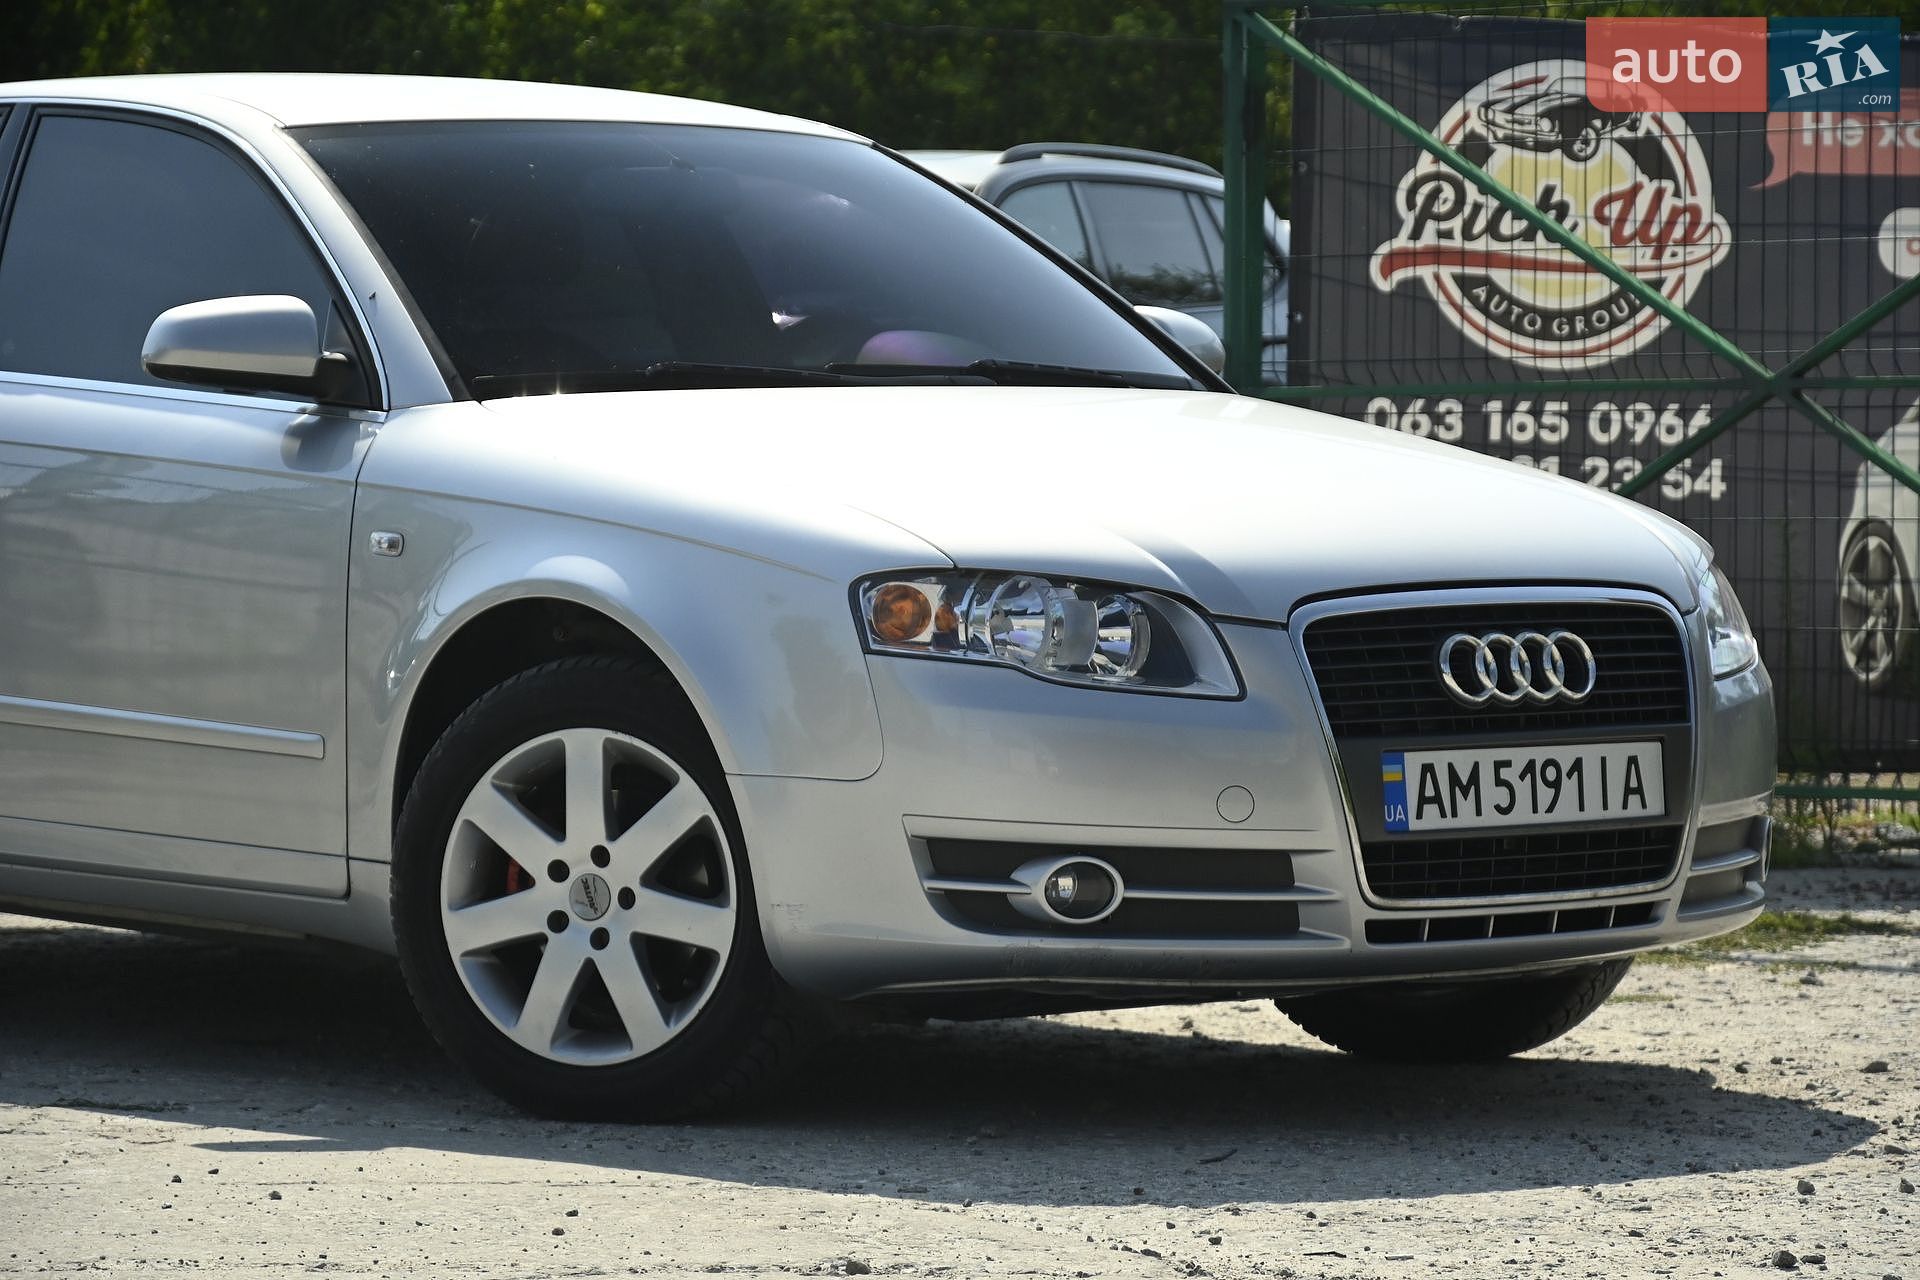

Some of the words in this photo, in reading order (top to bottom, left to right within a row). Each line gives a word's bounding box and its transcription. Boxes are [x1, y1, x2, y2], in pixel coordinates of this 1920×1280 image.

[1594, 180, 1714, 260] Up
[1472, 284, 1543, 331] AUTO
[1366, 397, 1464, 440] 063
[1482, 400, 1569, 443] 165
[1582, 456, 1644, 492] 23
[1660, 457, 1727, 499] 54
[1384, 804, 1407, 822] UA
